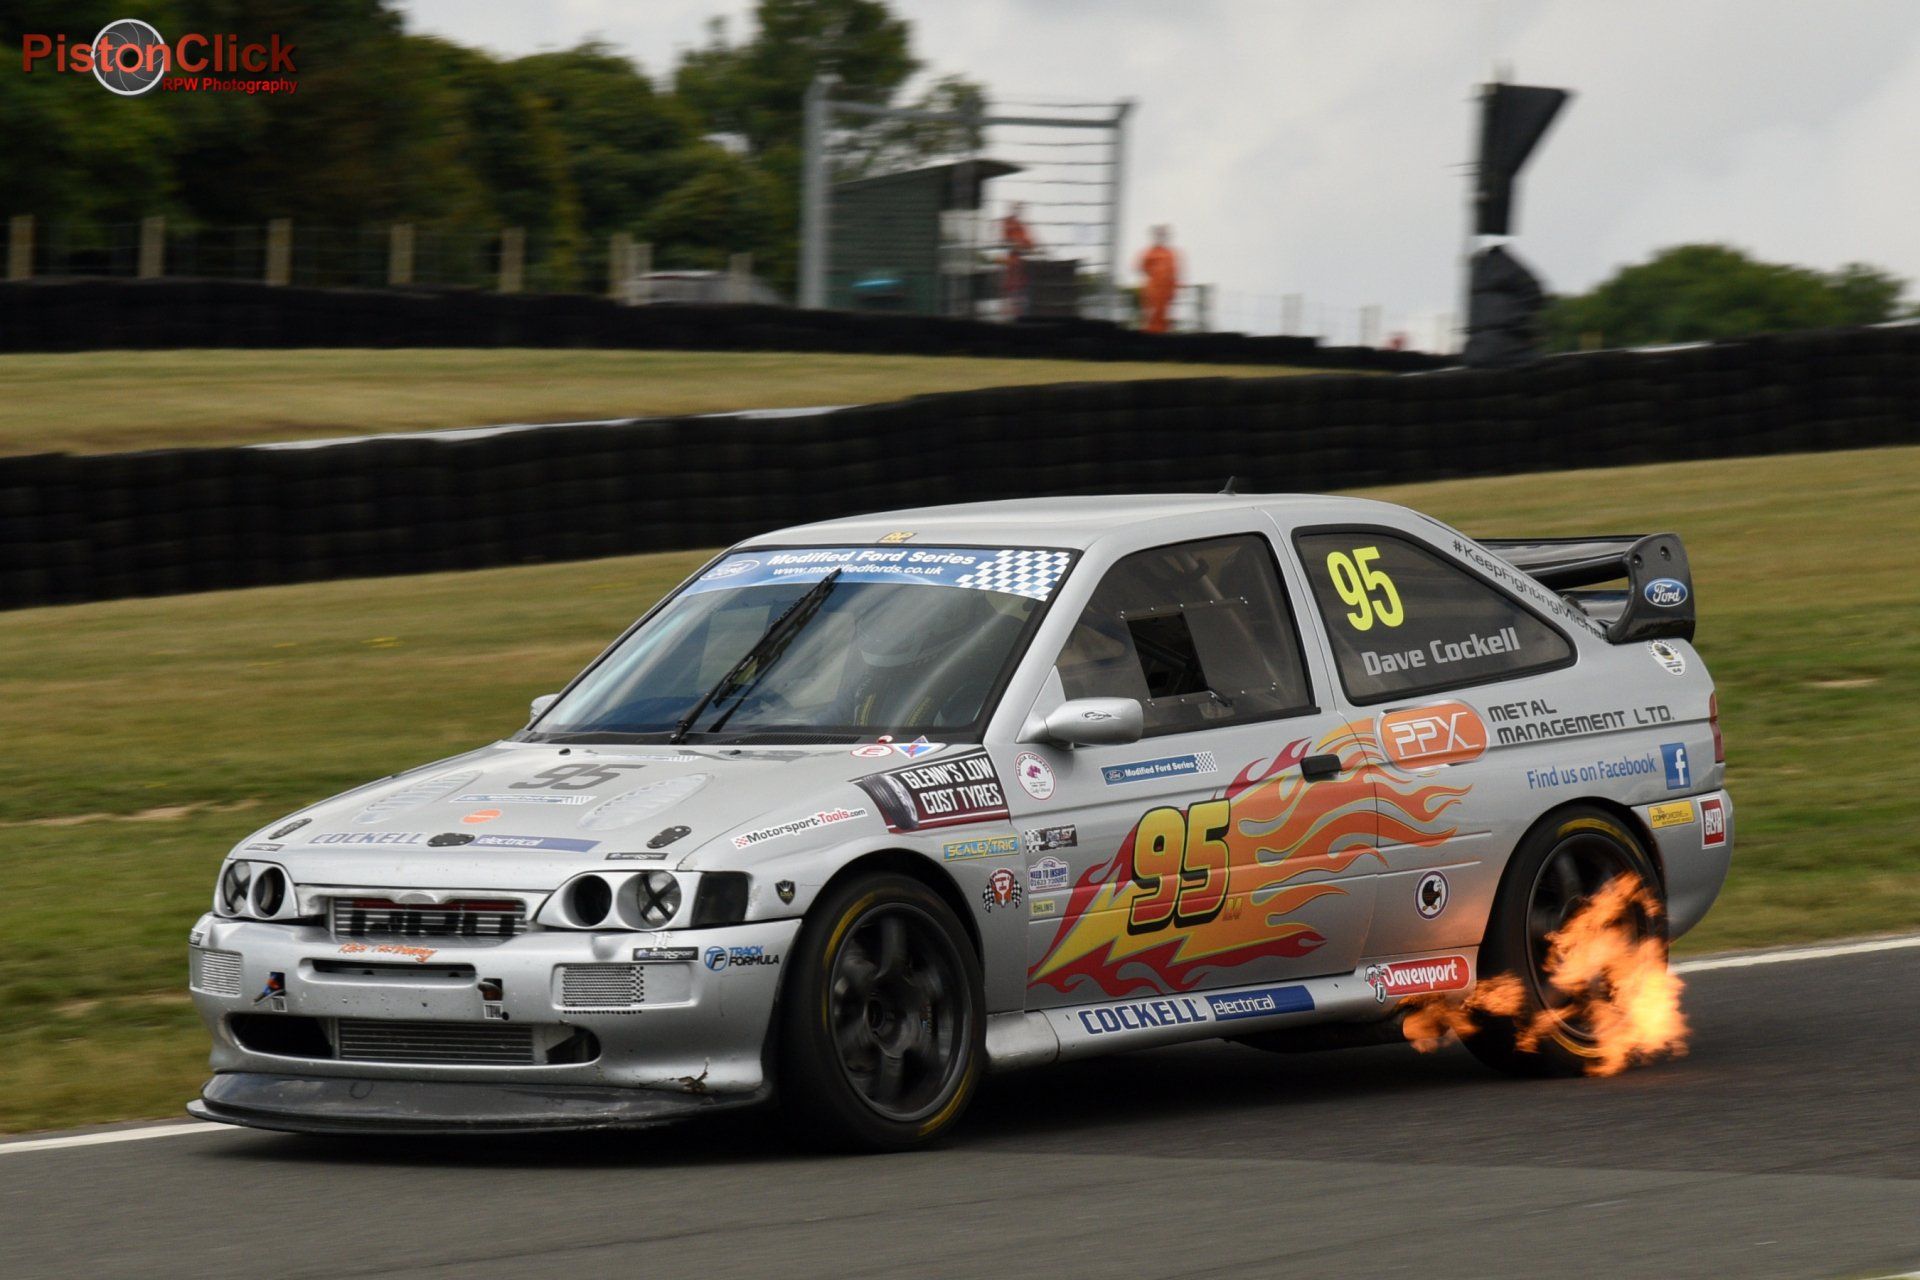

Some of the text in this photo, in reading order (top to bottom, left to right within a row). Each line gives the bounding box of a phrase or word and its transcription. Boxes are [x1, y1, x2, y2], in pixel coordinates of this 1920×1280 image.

[767, 551, 976, 566] Modified Ford Series
[1327, 546, 1404, 631] 95
[1453, 539, 1608, 641] #KeepFightingMichae
[1652, 583, 1681, 603] Ford
[1361, 627, 1521, 676] Dave Cockell
[1488, 699, 1557, 722] METAL
[1496, 705, 1675, 745] MANAGEMENT LTD.
[1387, 711, 1480, 760] PPX
[508, 763, 648, 790] 95
[900, 757, 995, 789] GLENN'S LOW
[1124, 766, 1155, 778] Modified
[1154, 763, 1171, 773] Ford
[1172, 761, 1195, 770] Series
[1527, 752, 1657, 790] Find us on Facebook
[919, 788, 959, 814] COST
[956, 782, 1003, 810] TYRES
[308, 832, 544, 847] COCKELL electrical
[746, 808, 866, 843] Motorsport-Tools.com
[947, 838, 1015, 857] SCALEXTRIC
[1127, 798, 1230, 936] 95
[728, 946, 764, 957] TRACK
[728, 955, 780, 967] FORMULA
[1381, 958, 1458, 989] Davenport
[1078, 994, 1276, 1035] COCKELL electrical
